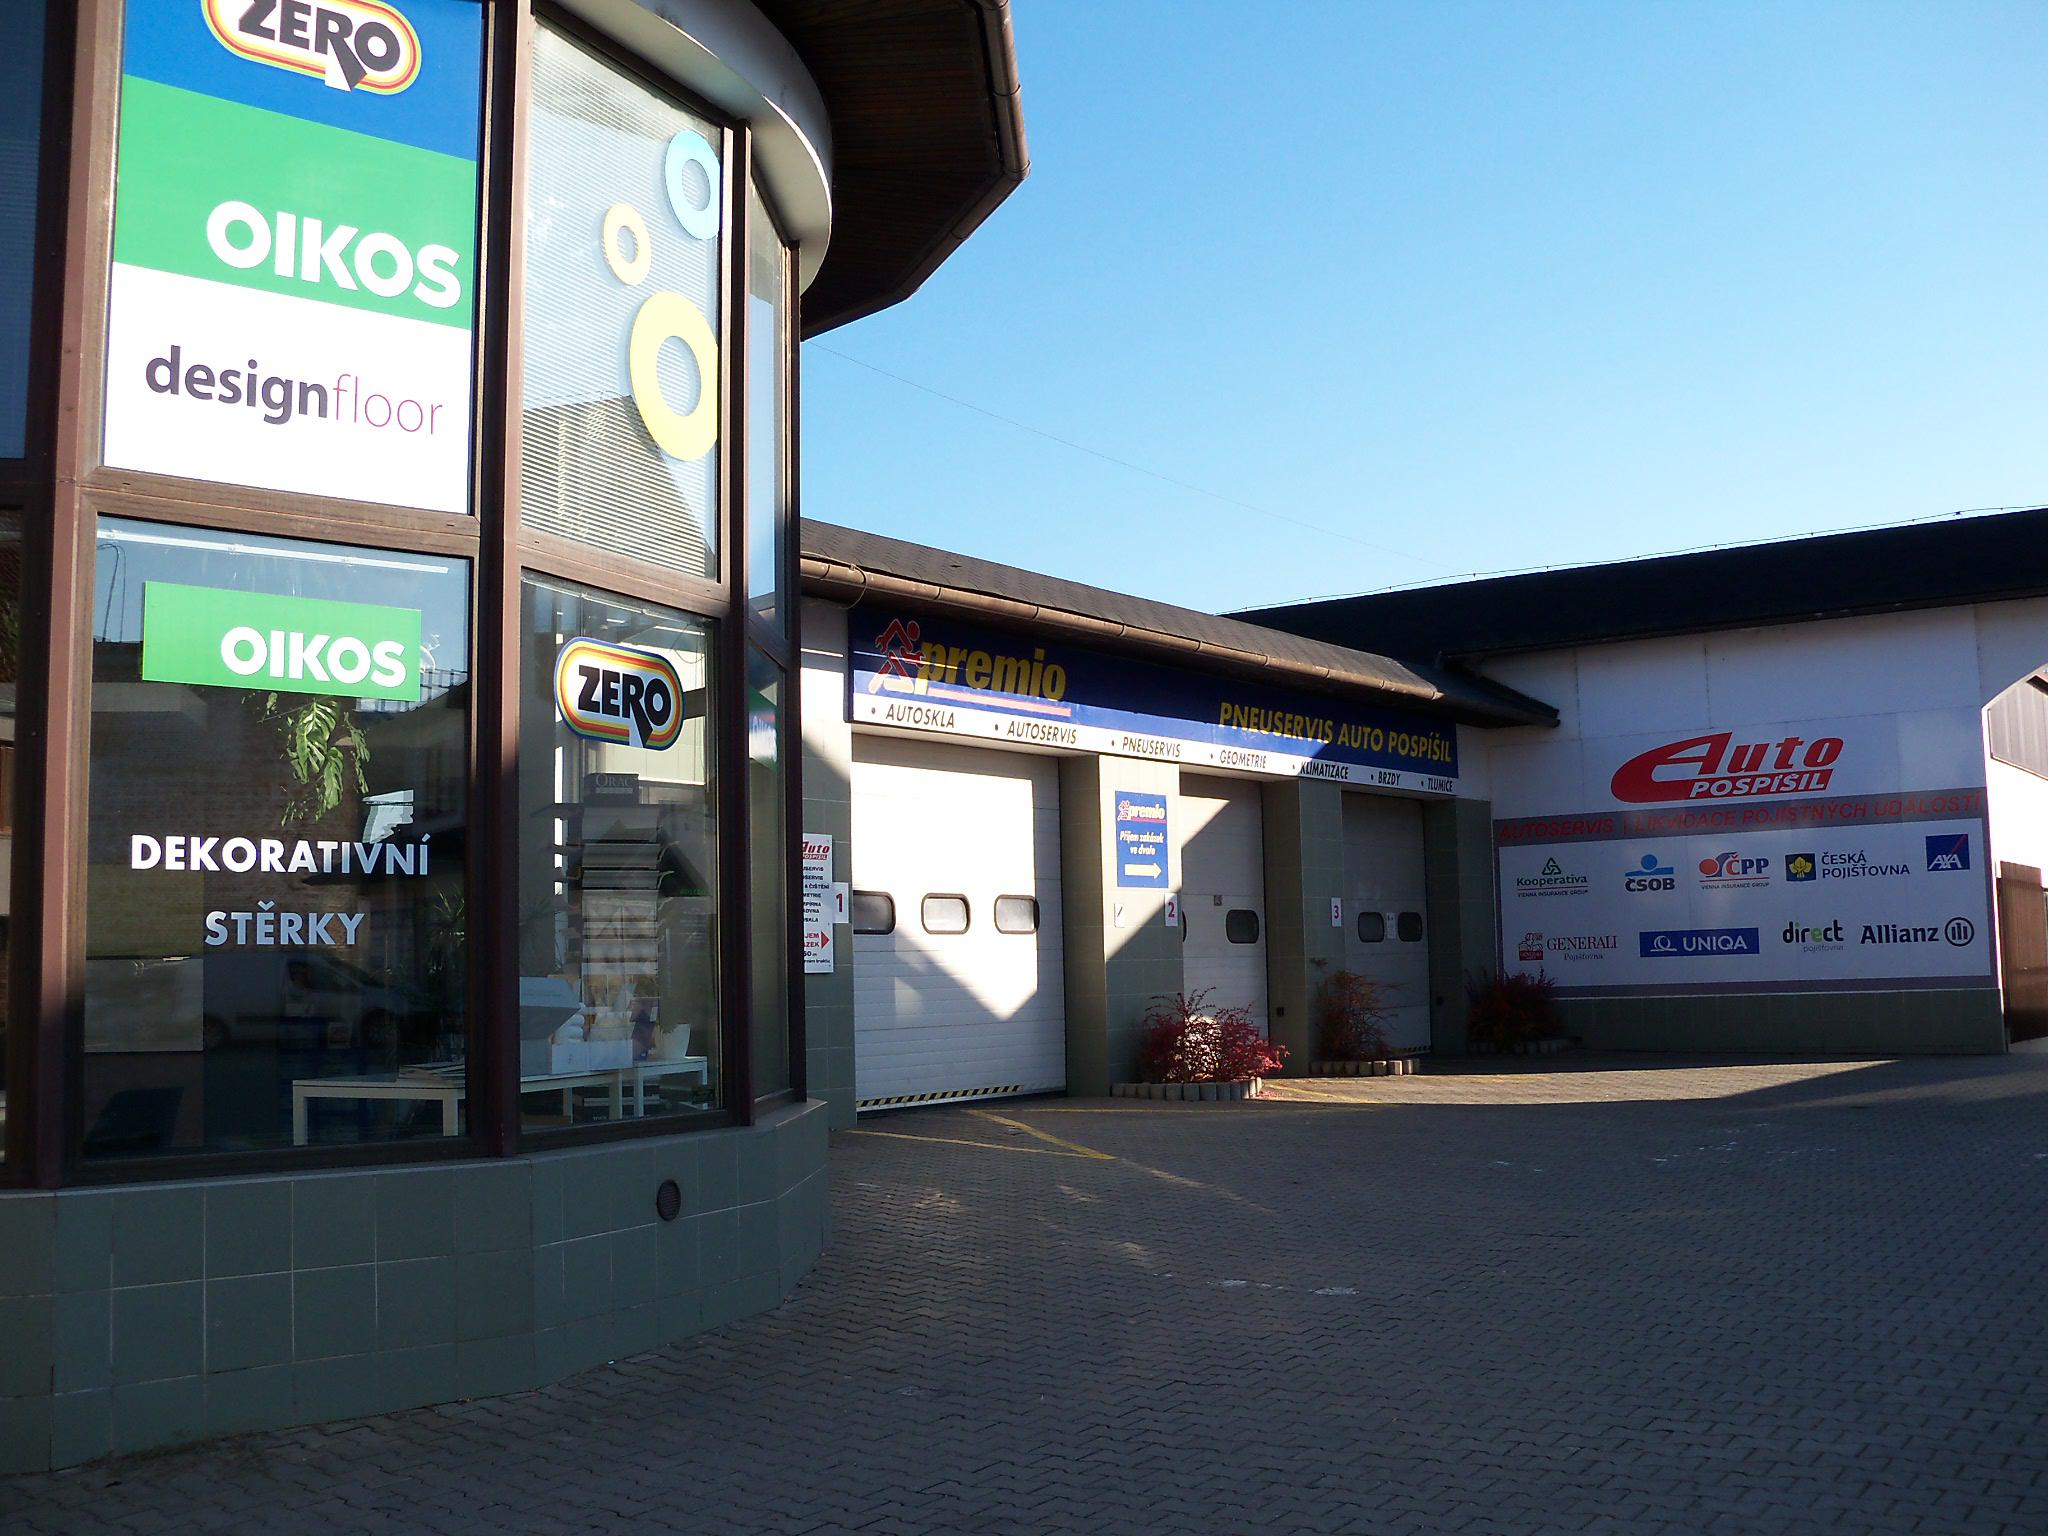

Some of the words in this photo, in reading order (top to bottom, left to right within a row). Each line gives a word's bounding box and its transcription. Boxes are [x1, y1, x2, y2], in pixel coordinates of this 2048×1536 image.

[239, 0, 401, 91] ZERO
[206, 200, 461, 308] OIKOS
[145, 344, 443, 436] designfloor
[220, 626, 406, 688] OIKOS
[913, 640, 1066, 701] premio
[578, 665, 672, 748] ZERO
[886, 703, 955, 729] AUTOSKLA
[1006, 720, 1077, 744] AUTOSERVIS
[1219, 702, 1334, 744] PNEUSERVIS
[1338, 721, 1384, 753] AUTO
[1388, 732, 1452, 763] POSPÍŠIL
[1122, 736, 1181, 757] PNEUSERVIS
[1219, 749, 1267, 769] GEOMETRIE
[1610, 731, 1844, 803] Auto
[1300, 761, 1349, 780] KLIMATIZACE
[1378, 771, 1400, 787] BRZDY
[1690, 772, 1826, 798] POSPÍŠIL
[1129, 804, 1165, 820] premio
[1500, 817, 1614, 842] AUTOSERVIS
[1634, 809, 1736, 833] LIKVIDACE
[1742, 799, 1867, 825] POJISTNÝCH
[131, 834, 430, 876] DEKORATIVNÍ
[1726, 854, 1769, 876] ČPP
[1821, 850, 1867, 865] ČESKÁ
[1928, 854, 1962, 870] AXA
[1516, 874, 1588, 887] Kooperativa
[1822, 864, 1910, 879] POJIŠŤOVNA
[1625, 877, 1675, 892] ČSOB
[836, 893, 843, 913] 1
[1168, 902, 1175, 917] 2
[1333, 905, 1340, 919] 3
[204, 900, 366, 946] STĚRKY
[1782, 919, 1844, 944] direct
[1547, 935, 1617, 951] GENERALI
[1682, 934, 1748, 952] UNIQA
[1860, 924, 1940, 944] Allianz
